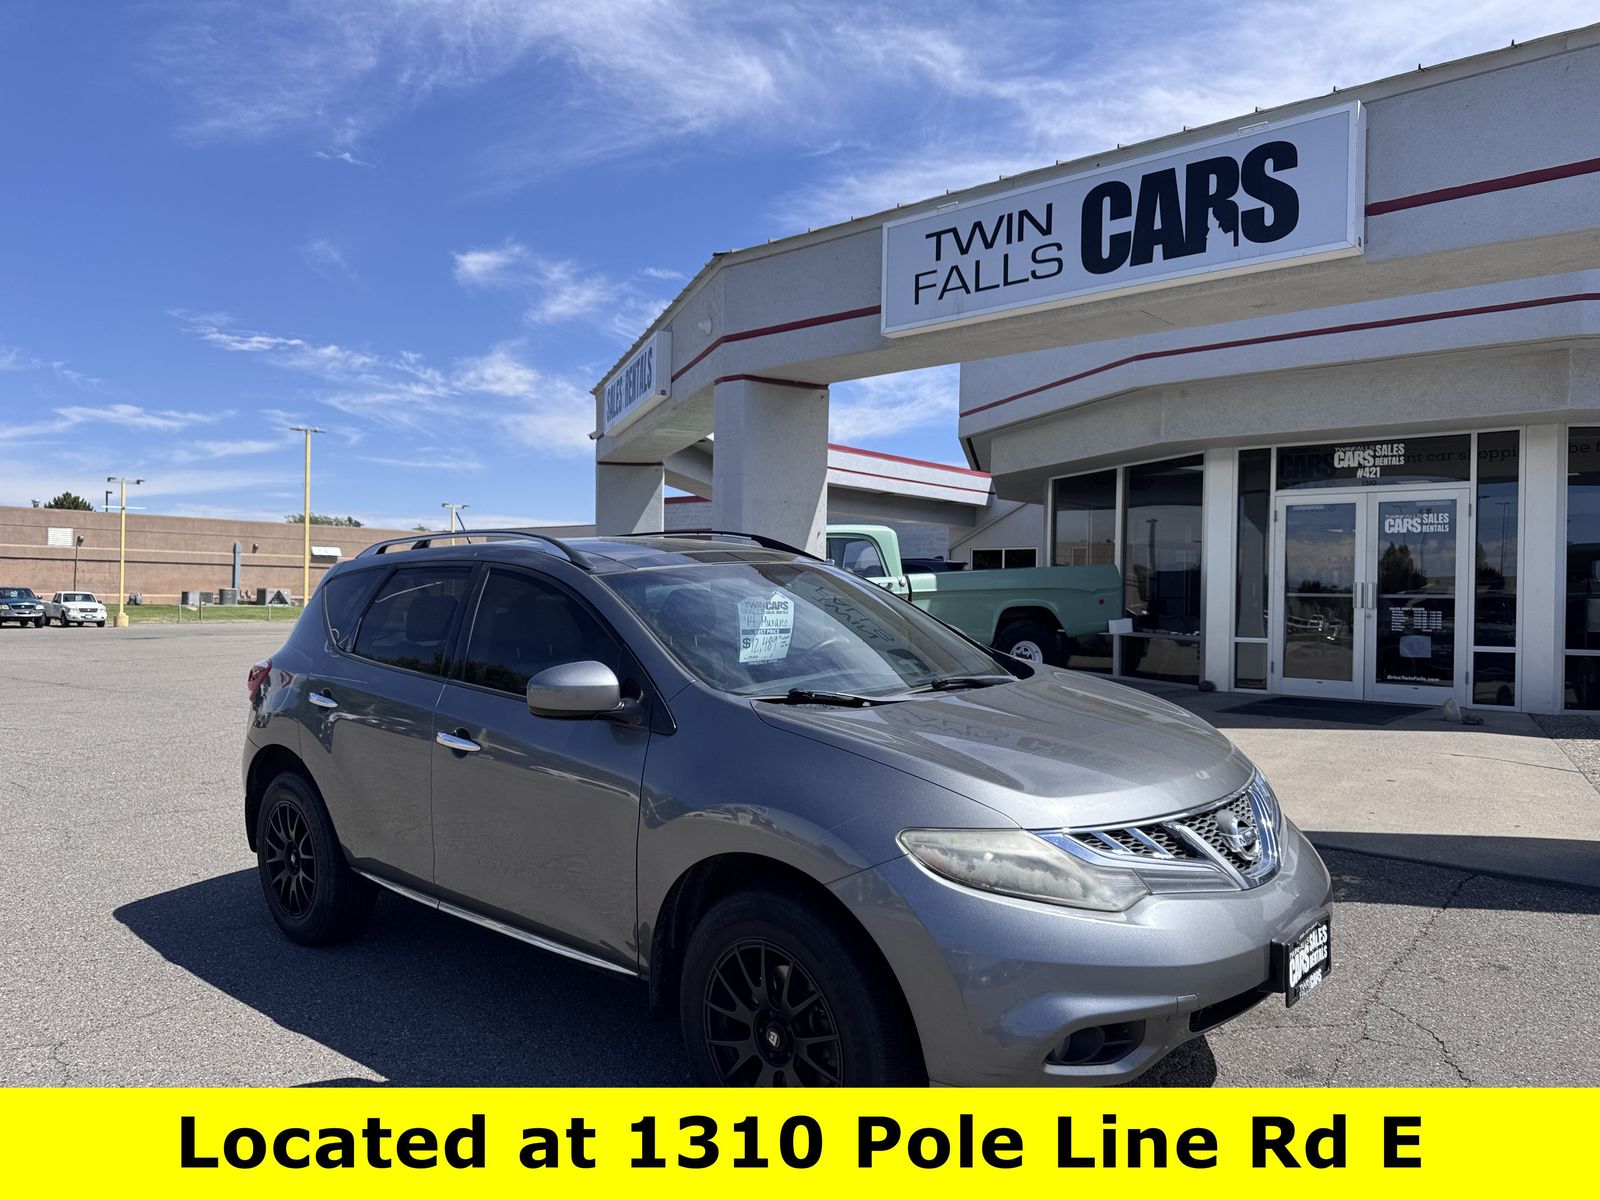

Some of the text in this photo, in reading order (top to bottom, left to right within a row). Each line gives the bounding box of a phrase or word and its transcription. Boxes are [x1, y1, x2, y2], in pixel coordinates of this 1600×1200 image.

[1081, 140, 1300, 275] CARS
[925, 202, 1054, 262] TWIN
[915, 242, 1064, 305] FALLS
[607, 346, 653, 423] SALES RENTALS
[1375, 443, 1405, 456] SALES
[1333, 450, 1374, 468] CARS
[1375, 456, 1405, 466] RENTALS
[1356, 466, 1381, 478] #421
[1384, 518, 1421, 533] CARS
[1422, 513, 1449, 524] SALES
[1422, 524, 1449, 533] RENTALS
[765, 601, 789, 611] CARS
